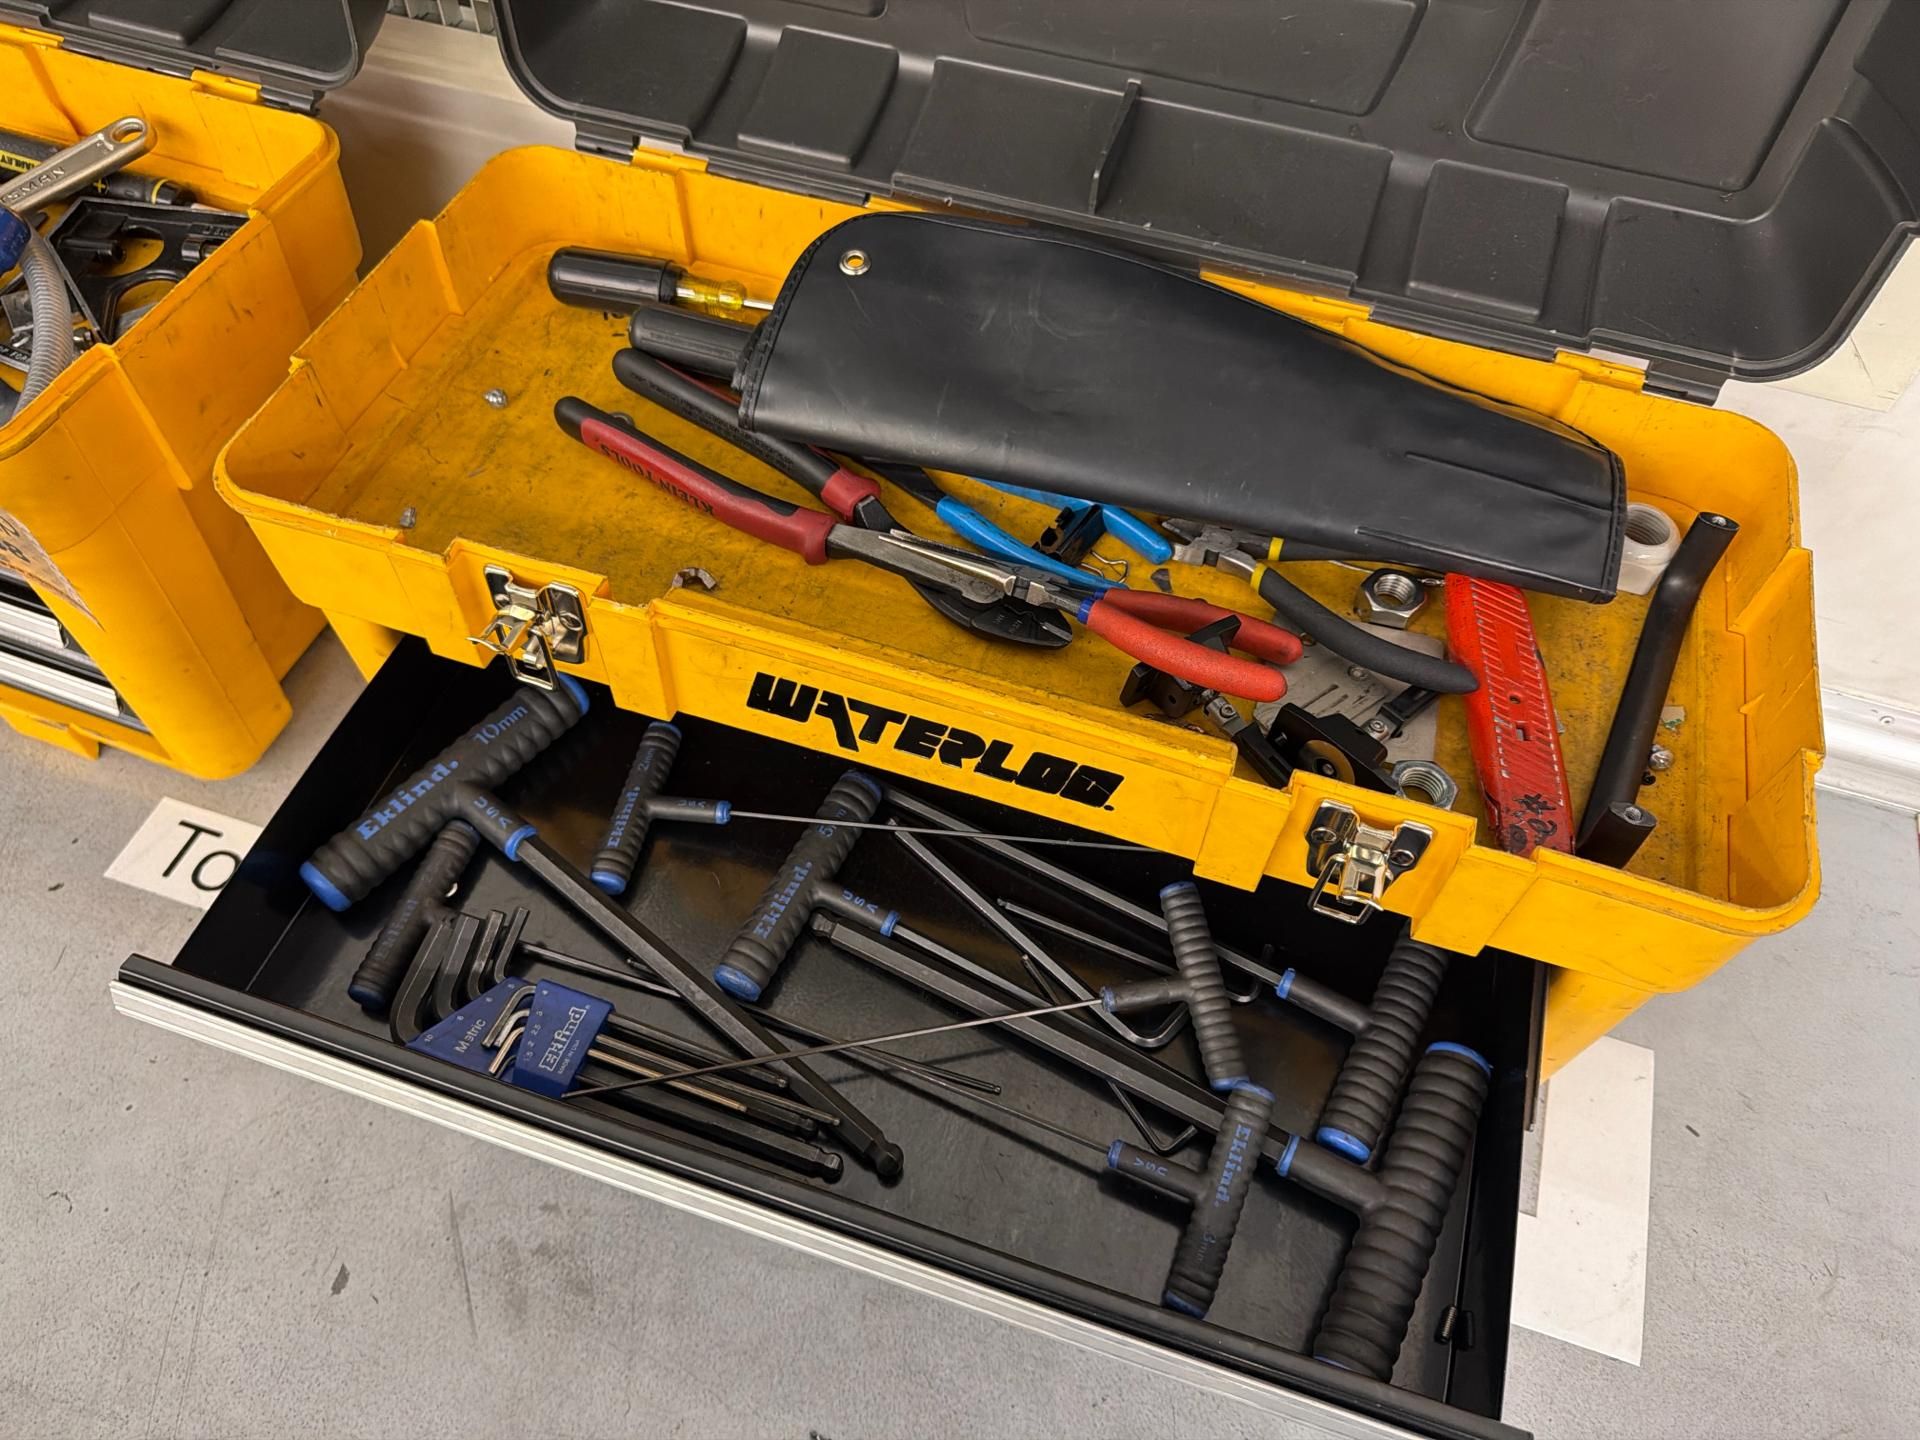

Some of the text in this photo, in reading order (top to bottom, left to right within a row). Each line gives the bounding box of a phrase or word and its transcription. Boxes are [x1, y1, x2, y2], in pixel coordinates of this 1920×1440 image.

[600, 443, 715, 515] KLEIN TOOLS
[473, 705, 528, 744] 10mm
[473, 796, 512, 829] USA
[162, 820, 241, 891] To
[842, 889, 878, 913] USA
[455, 1018, 486, 1053] Metric
[539, 1006, 587, 1072] Eklind
[1134, 1157, 1168, 1176] USA
